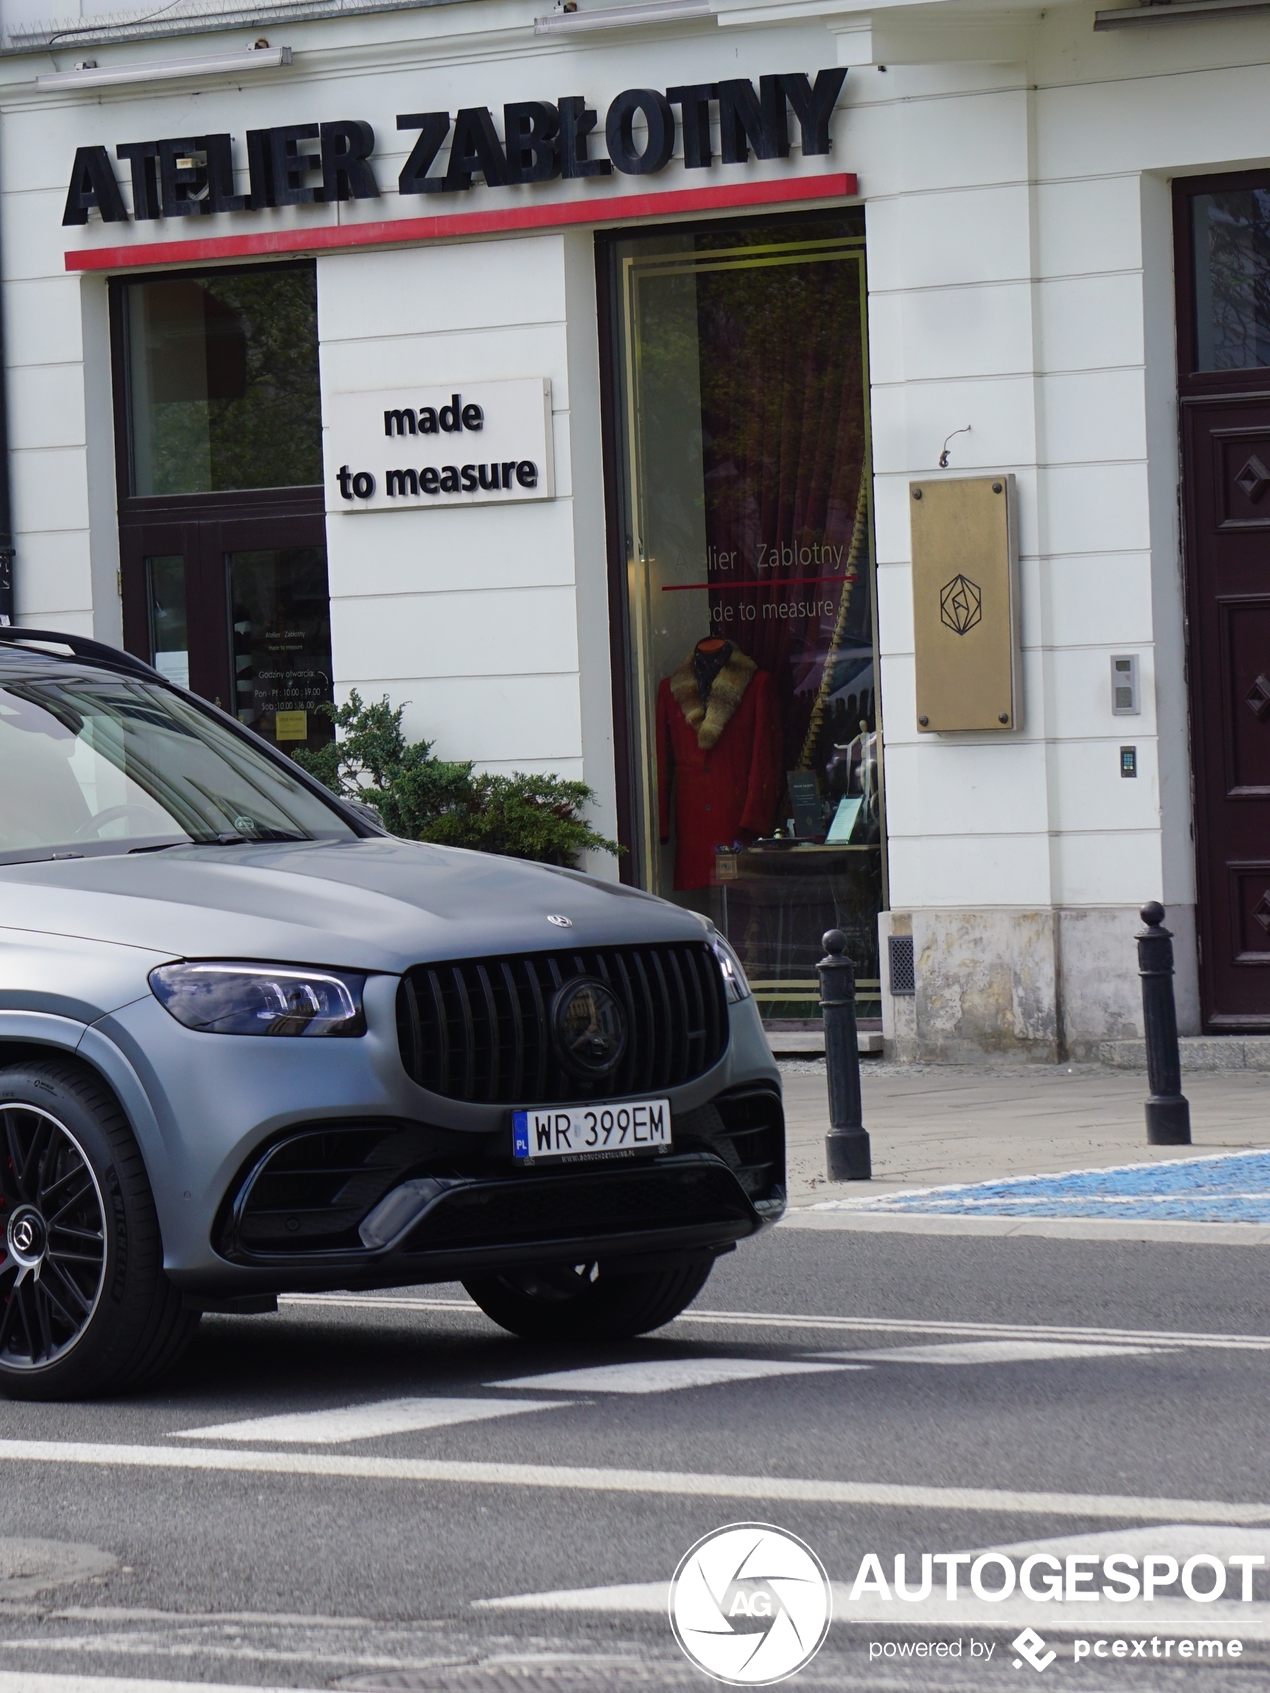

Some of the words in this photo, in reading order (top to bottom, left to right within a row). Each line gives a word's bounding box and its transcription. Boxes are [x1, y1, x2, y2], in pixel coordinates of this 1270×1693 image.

[62, 119, 381, 227] ATELIER
[396, 67, 849, 196] ZABŁOTNY
[383, 393, 484, 437] made
[336, 465, 375, 501] to
[385, 457, 538, 498] measure
[756, 540, 844, 570] Zablotny
[738, 602, 756, 622] to
[762, 599, 834, 621] measure
[258, 670, 284, 679] Godziny
[262, 702, 274, 710] Sob
[516, 1139, 528, 1151] PL
[534, 1113, 573, 1151] WR
[583, 1104, 665, 1147] 399EM
